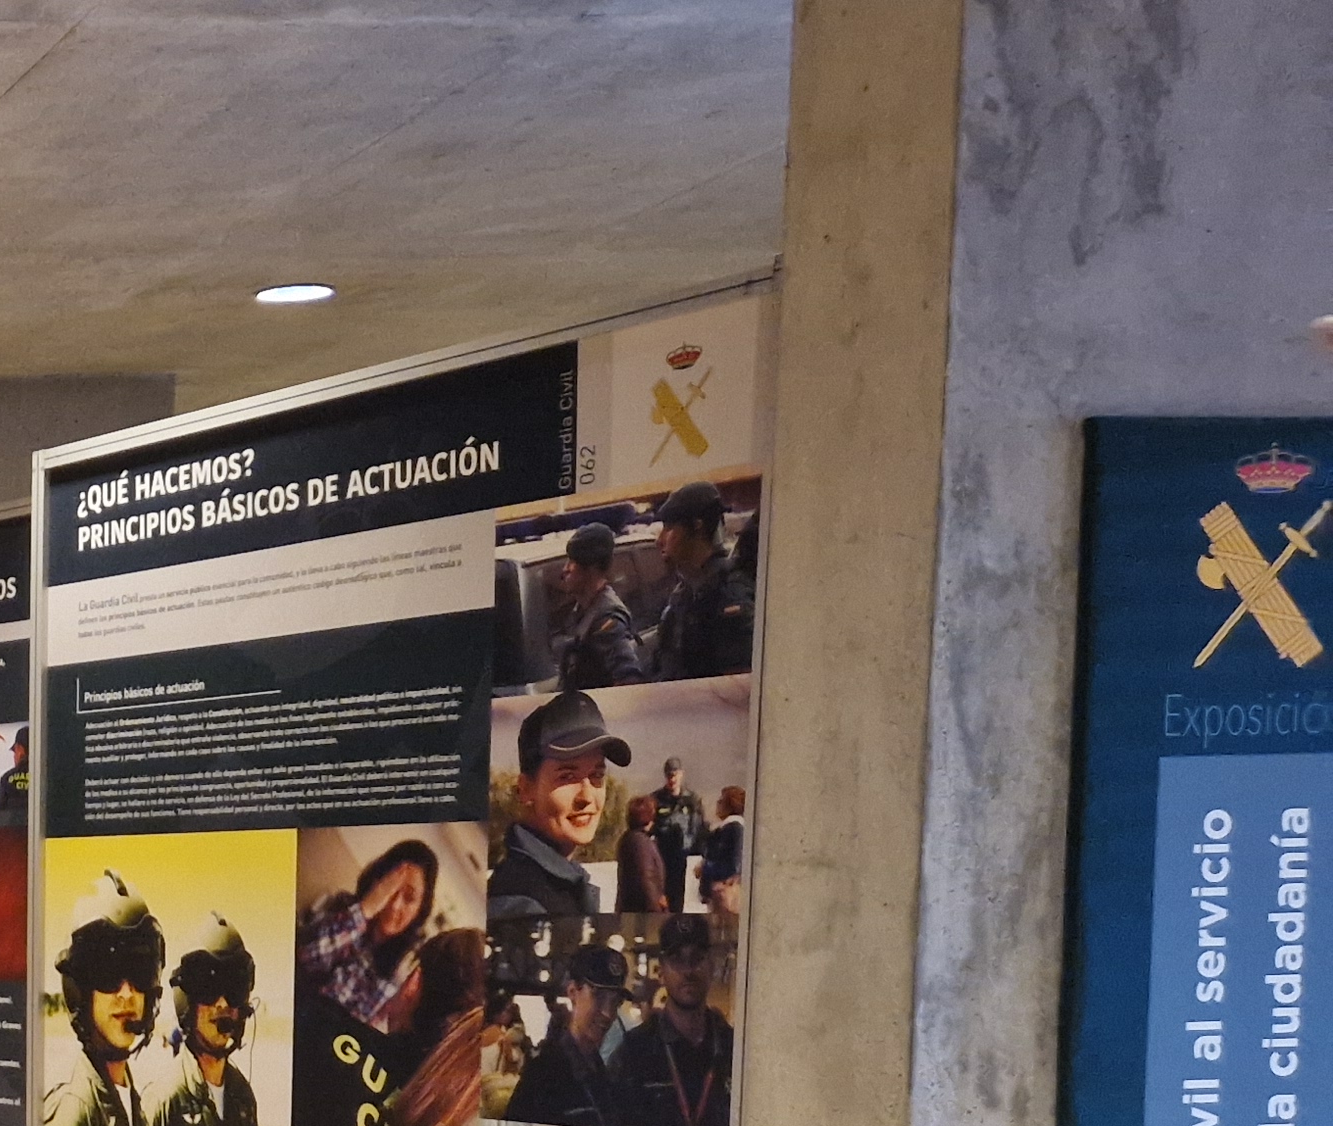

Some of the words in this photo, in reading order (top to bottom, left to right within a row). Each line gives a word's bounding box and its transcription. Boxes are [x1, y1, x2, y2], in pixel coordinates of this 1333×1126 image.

[559, 368, 573, 412] Civil
[558, 416, 574, 491] Guardia
[579, 444, 596, 486] 062
[77, 471, 129, 519] ¿QUÉ
[135, 448, 255, 504] HACEMOS?
[78, 506, 195, 551] PRINCIPIOS
[201, 482, 300, 527] BÁSICOS
[307, 474, 339, 507] DE
[346, 436, 501, 500] ACTUACIÓN
[89, 595, 120, 611] Guardia
[84, 689, 123, 705] Principios
[124, 684, 154, 700] básicos
[155, 683, 165, 696] de
[166, 679, 205, 695] actuación
[1190, 808, 1234, 1004] servicio
[1261, 805, 1313, 1078] ciudadanía
[1185, 1016, 1222, 1062] al
